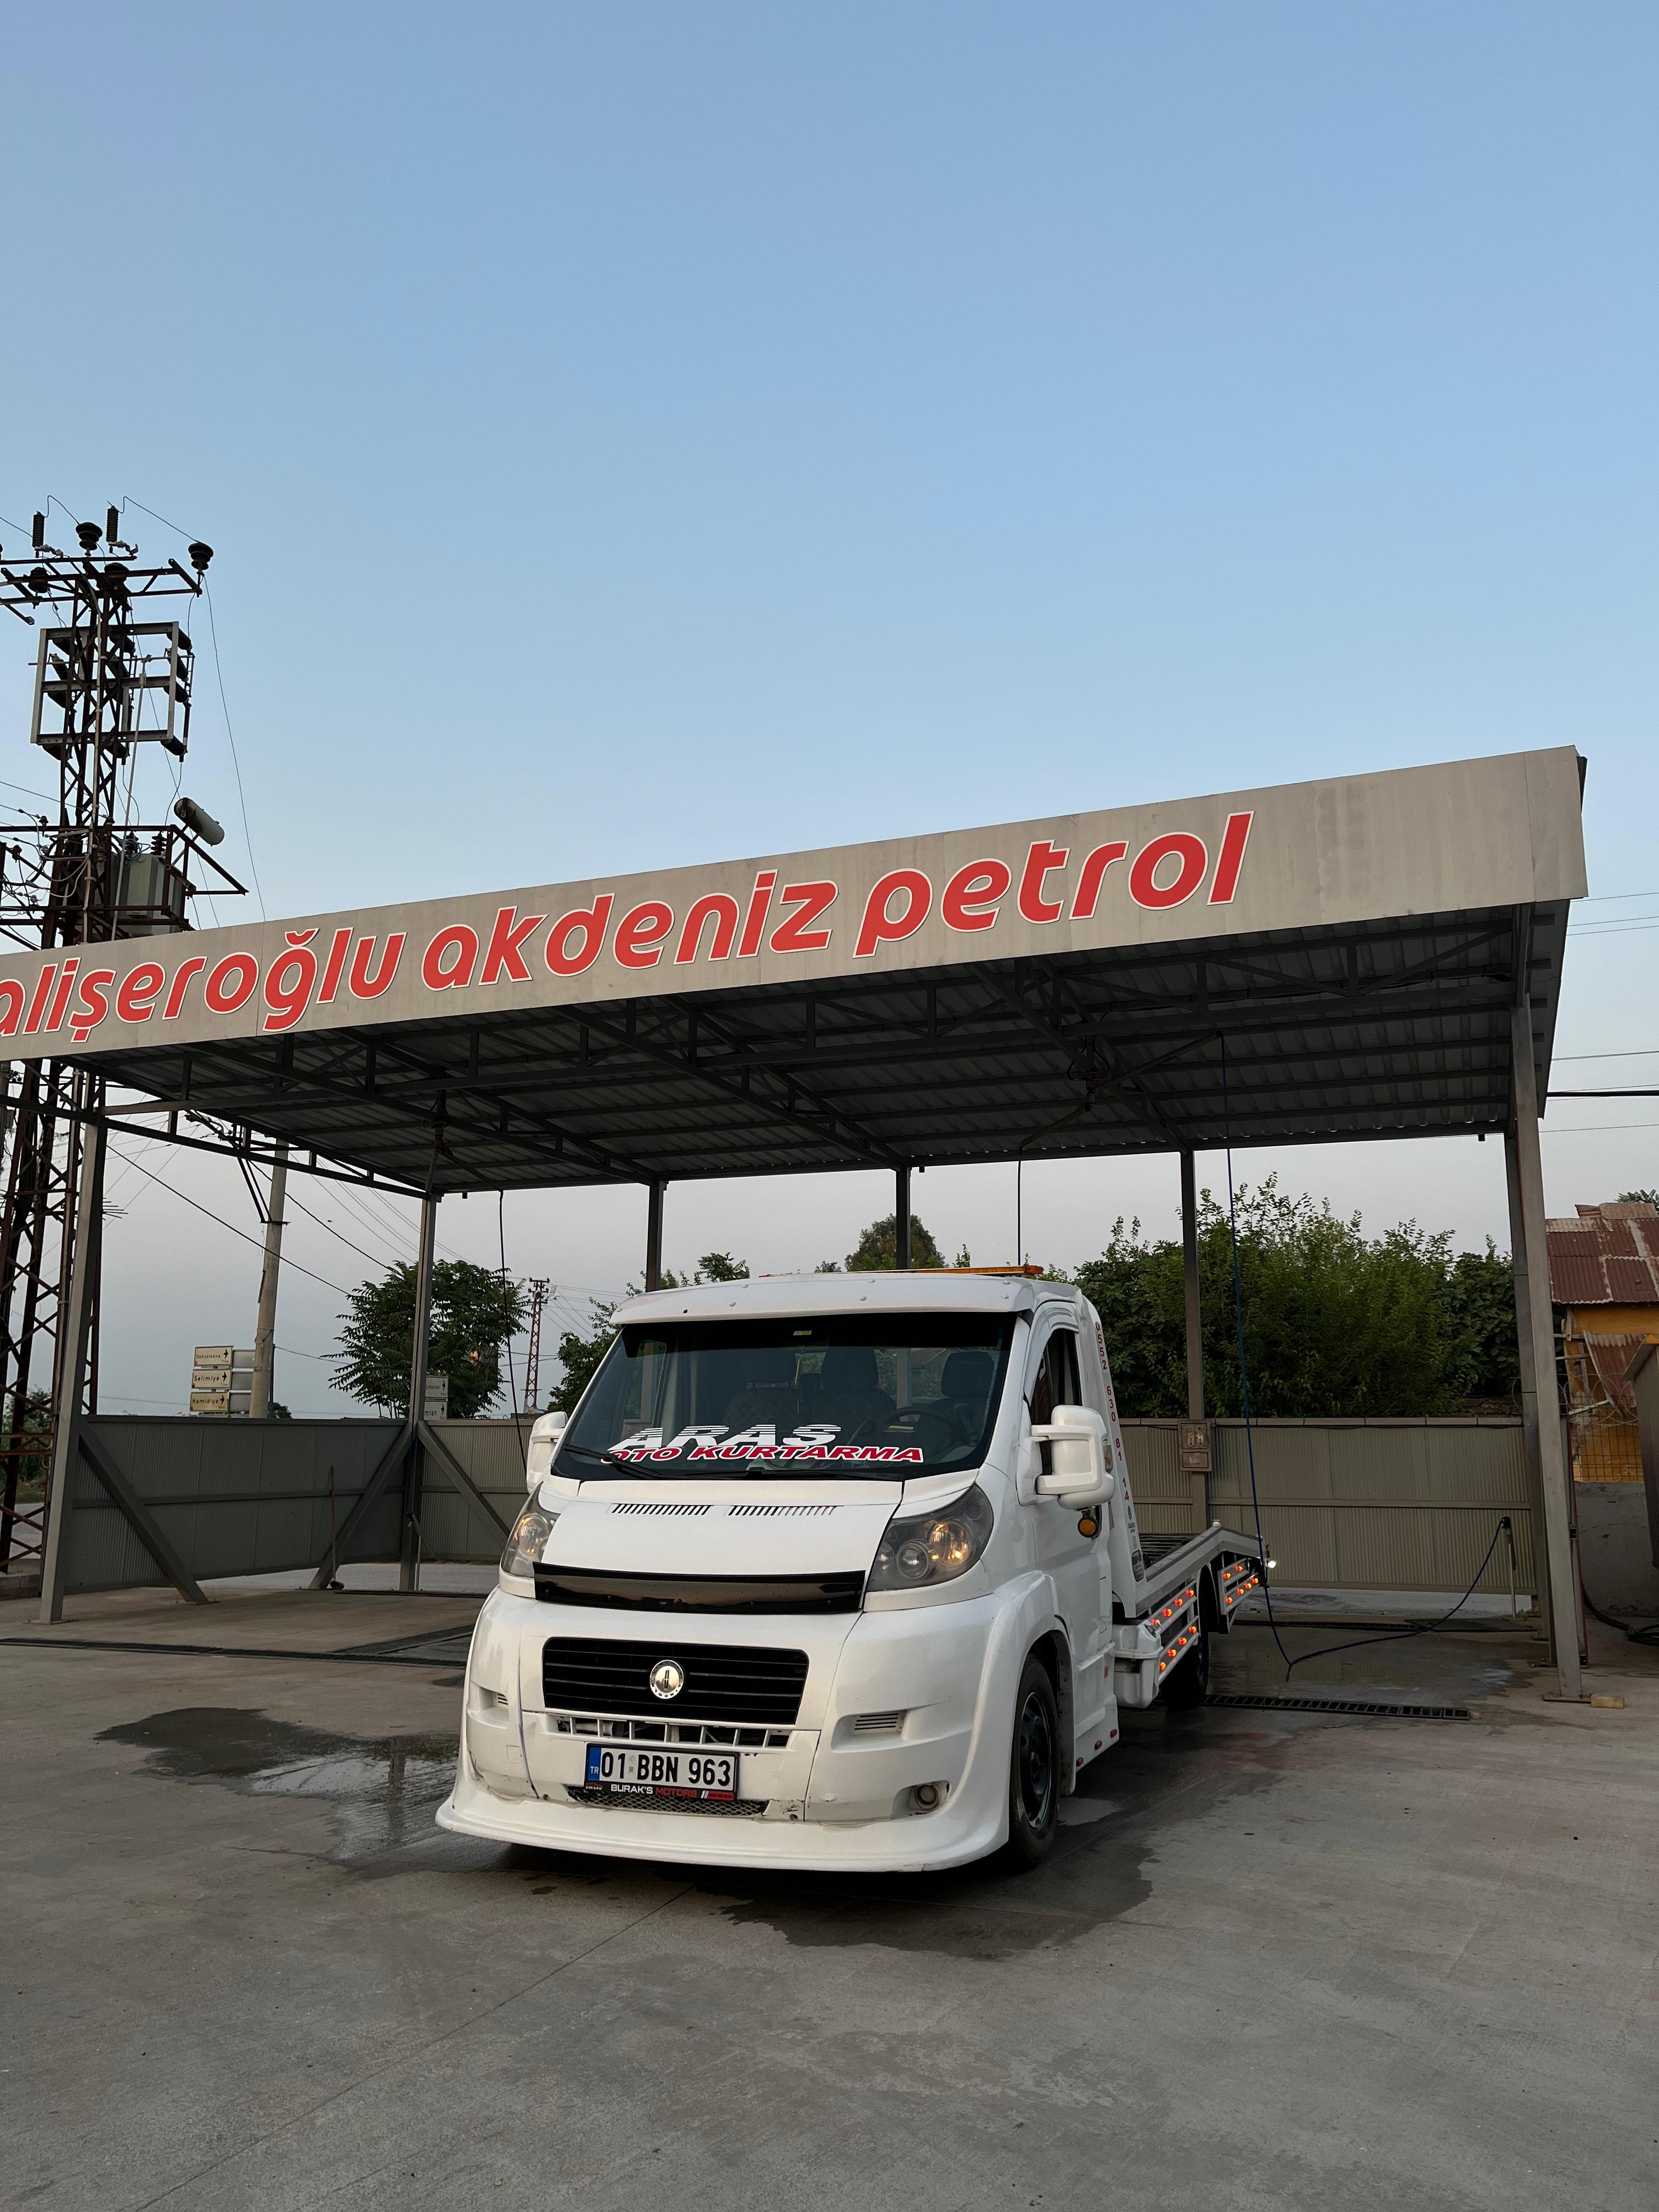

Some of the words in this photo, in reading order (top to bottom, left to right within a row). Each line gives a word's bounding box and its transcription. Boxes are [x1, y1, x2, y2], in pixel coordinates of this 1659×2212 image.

[0, 927, 408, 1043] alişeroğlu
[421, 869, 839, 991] akdeniz
[853, 810, 1255, 958] petrol
[1095, 1321, 1107, 1370] 0552
[1107, 1386, 1116, 1422] 630
[1115, 1438, 1122, 1462] 81
[1122, 1477, 1129, 1501] 14
[607, 1424, 842, 1451] ARAS
[601, 1446, 682, 1464] OTO
[687, 1445, 924, 1463] KURTARMA
[590, 1766, 599, 1774] TR
[601, 1752, 626, 1779] 01
[636, 1754, 679, 1783] BBN
[688, 1757, 731, 1787] 963
[611, 1784, 653, 1795] BURAK'S
[655, 1787, 697, 1798] MOTORS
